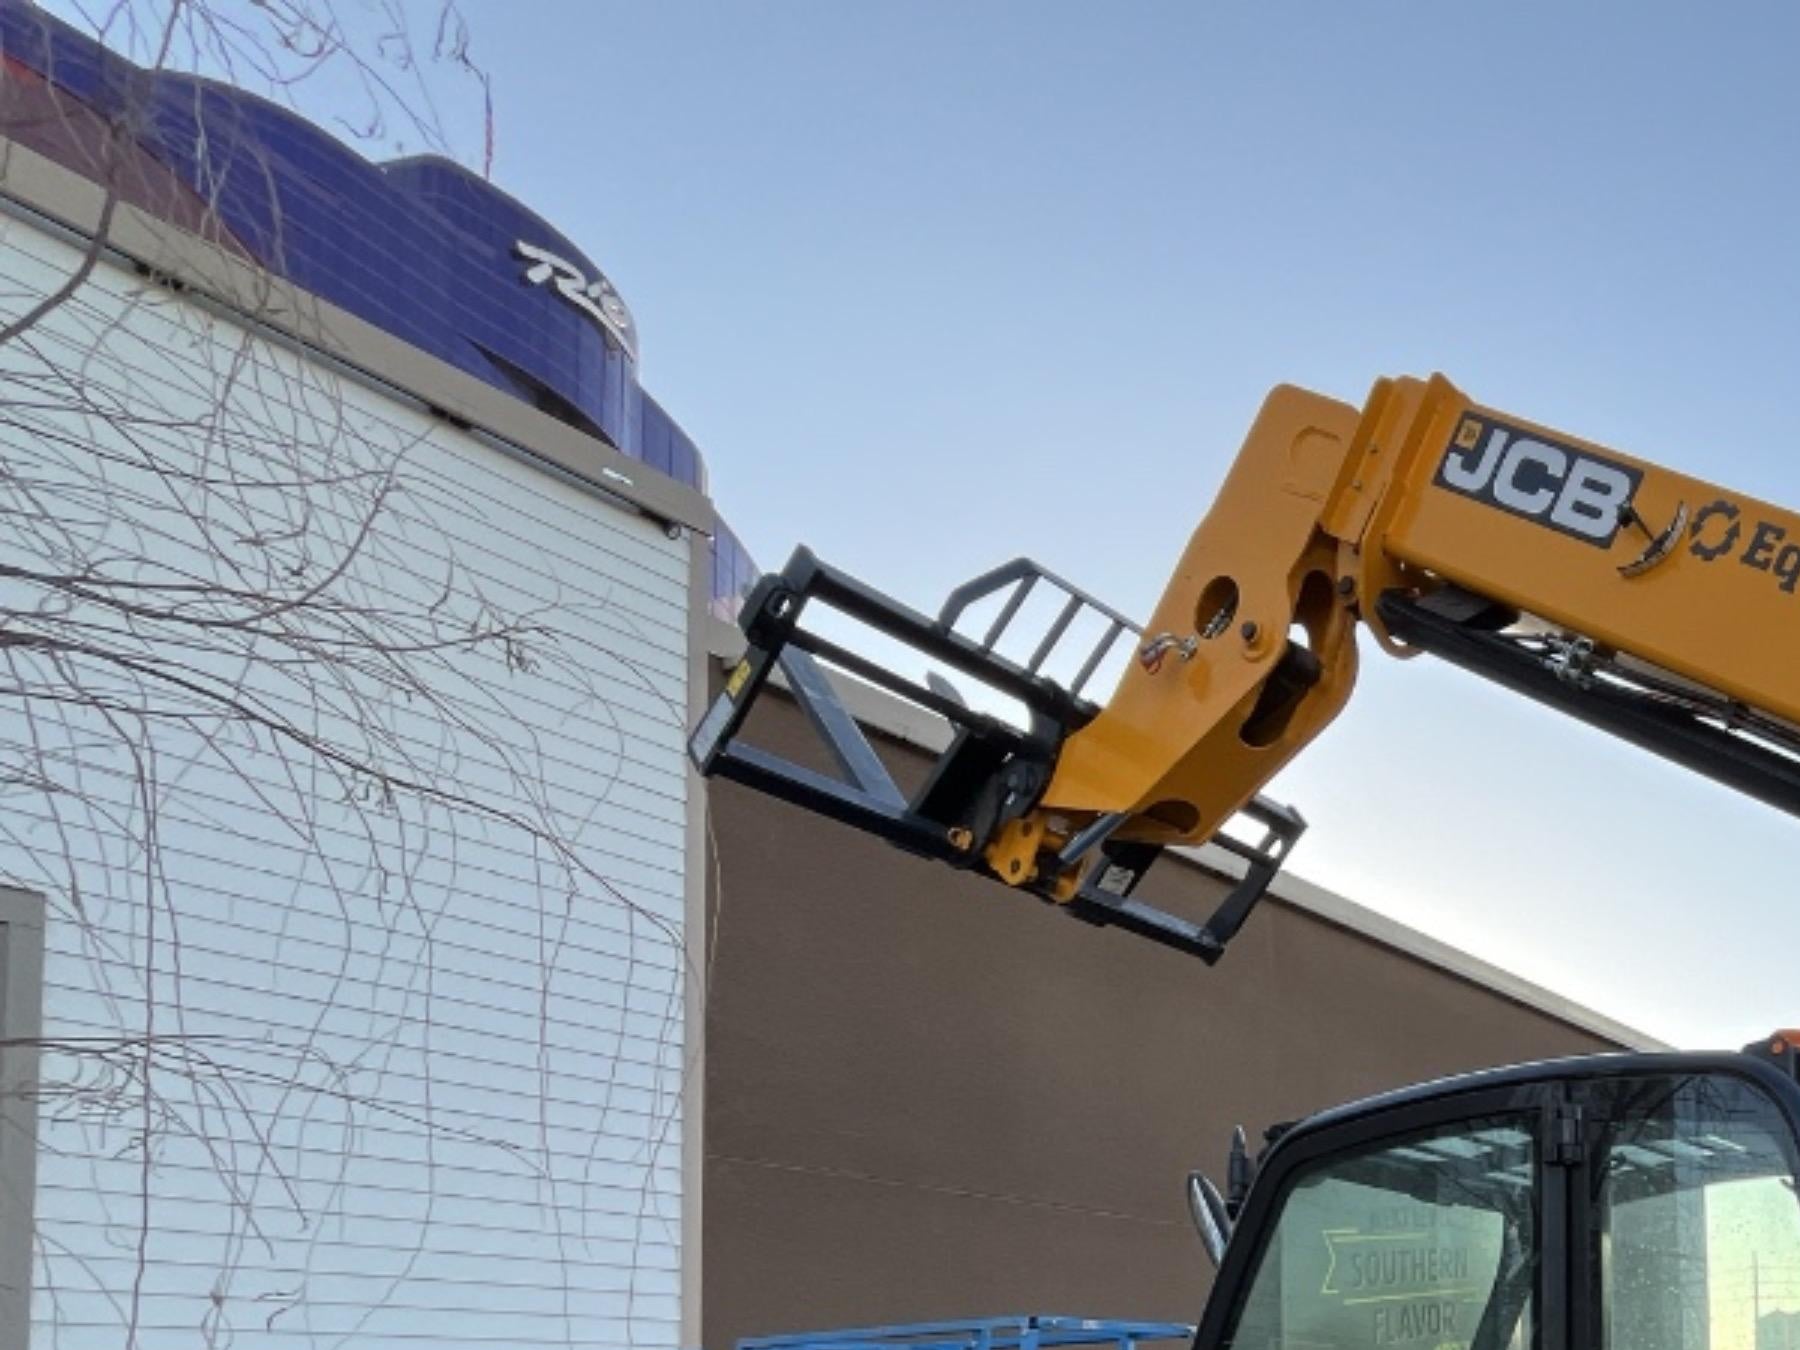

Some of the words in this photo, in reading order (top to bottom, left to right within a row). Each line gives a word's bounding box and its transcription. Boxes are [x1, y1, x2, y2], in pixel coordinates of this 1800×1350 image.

[1443, 427, 1630, 538] JCB
[1351, 1247, 1469, 1290] SOUTHERN
[1374, 1303, 1457, 1345] FLAVOR
